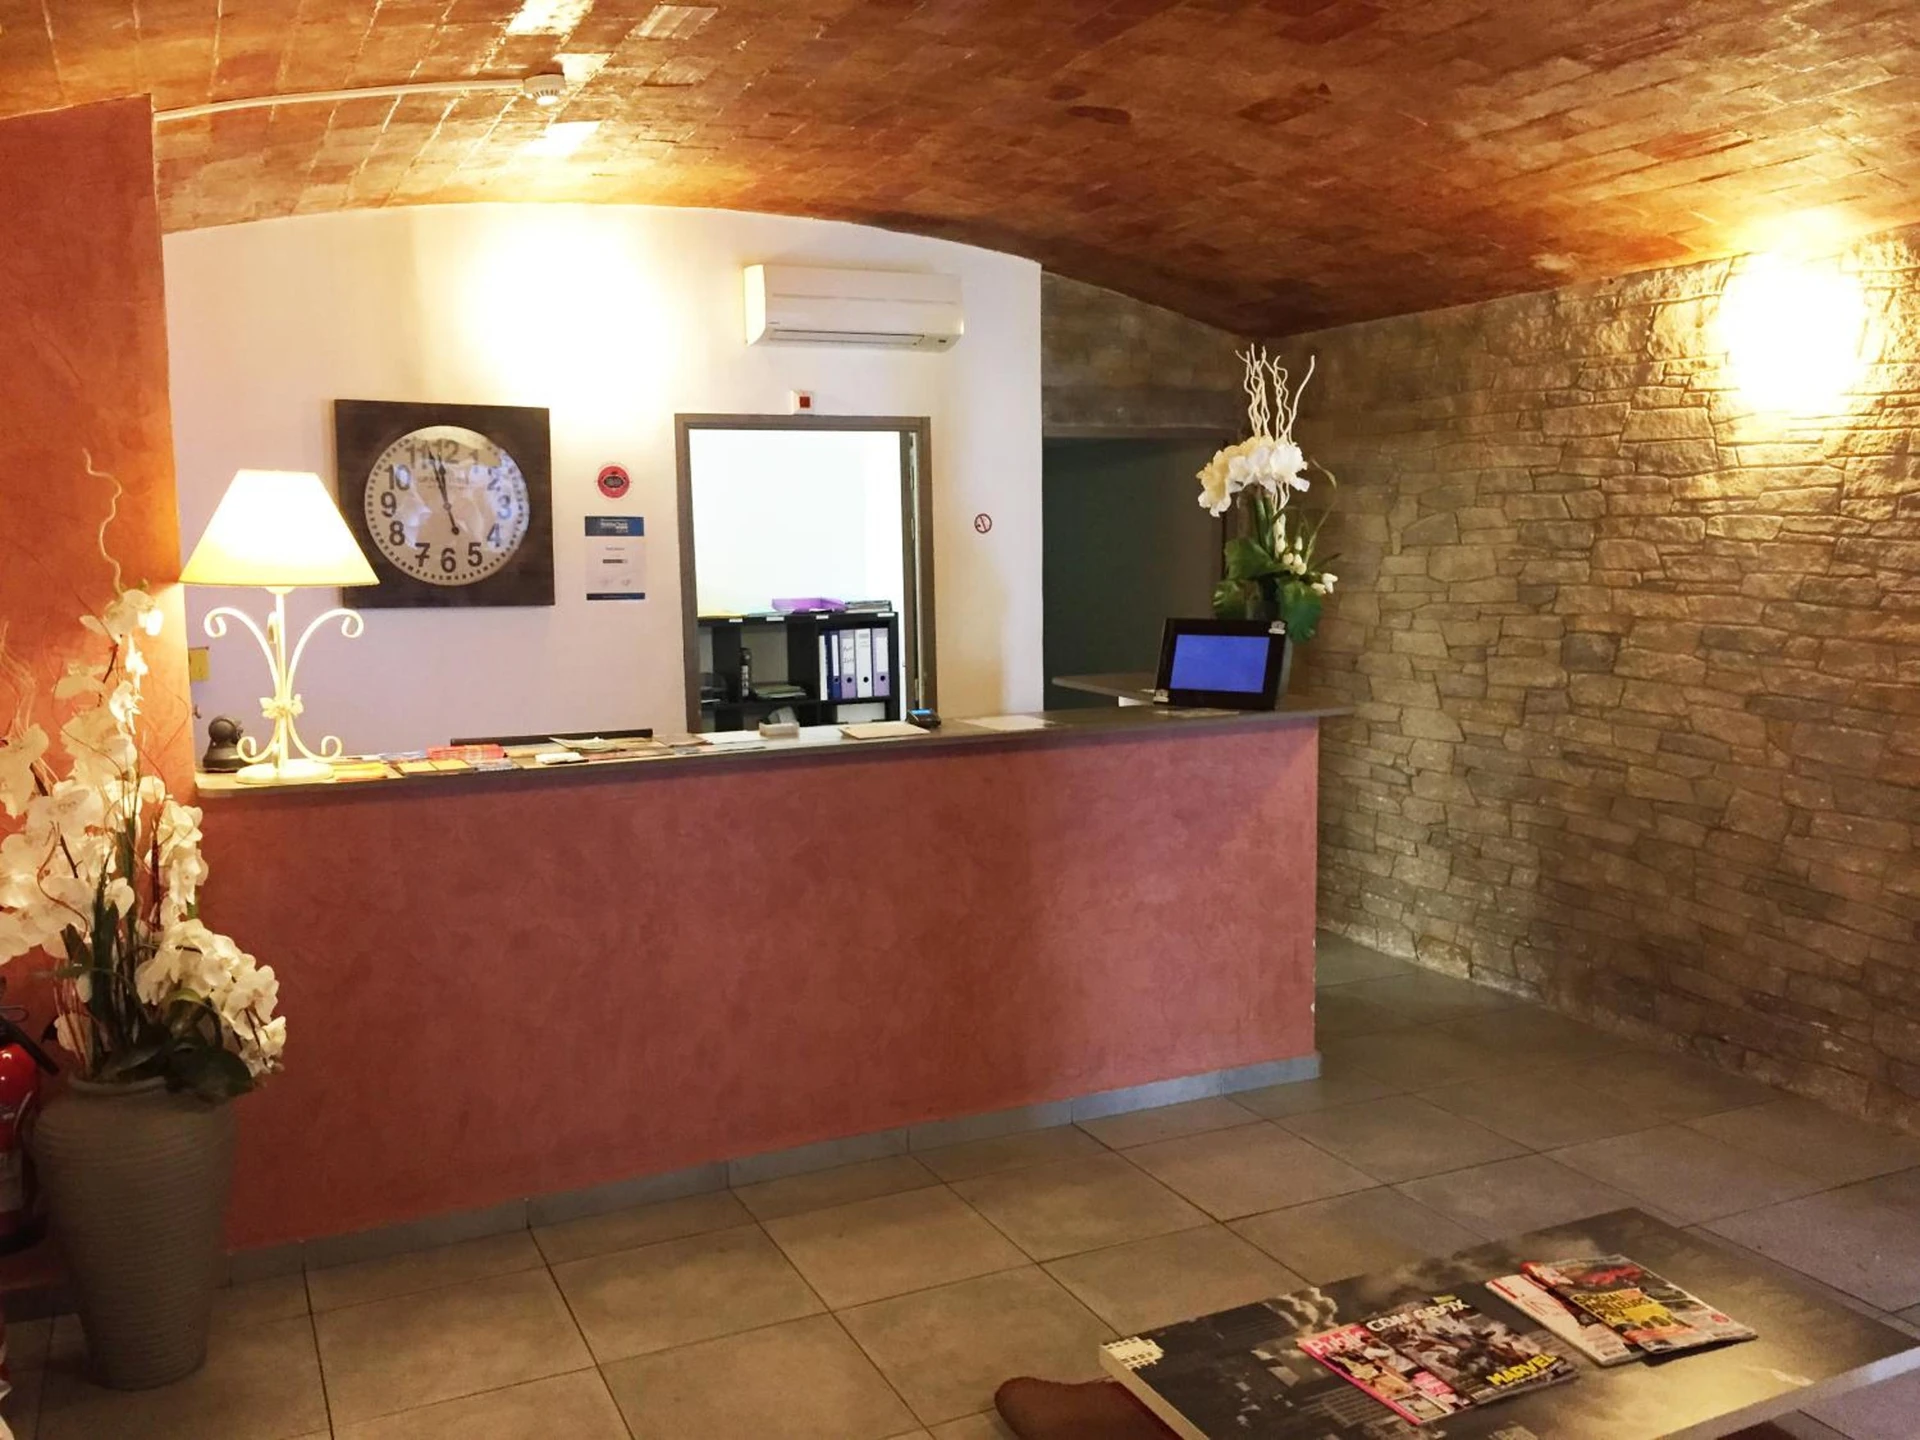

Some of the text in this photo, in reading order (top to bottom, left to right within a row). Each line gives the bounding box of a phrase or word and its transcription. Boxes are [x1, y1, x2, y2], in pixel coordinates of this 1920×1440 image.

[433, 439, 460, 464] 12
[385, 463, 411, 491] 10
[487, 467, 501, 491] 2
[380, 492, 397, 518] 9
[498, 495, 512, 520] 3
[389, 521, 406, 546] 8
[487, 523, 501, 548] 4
[415, 542, 431, 568] 7
[441, 548, 456, 573] 6
[468, 542, 483, 567] 5
[1487, 1353, 1556, 1386] MARVEL
